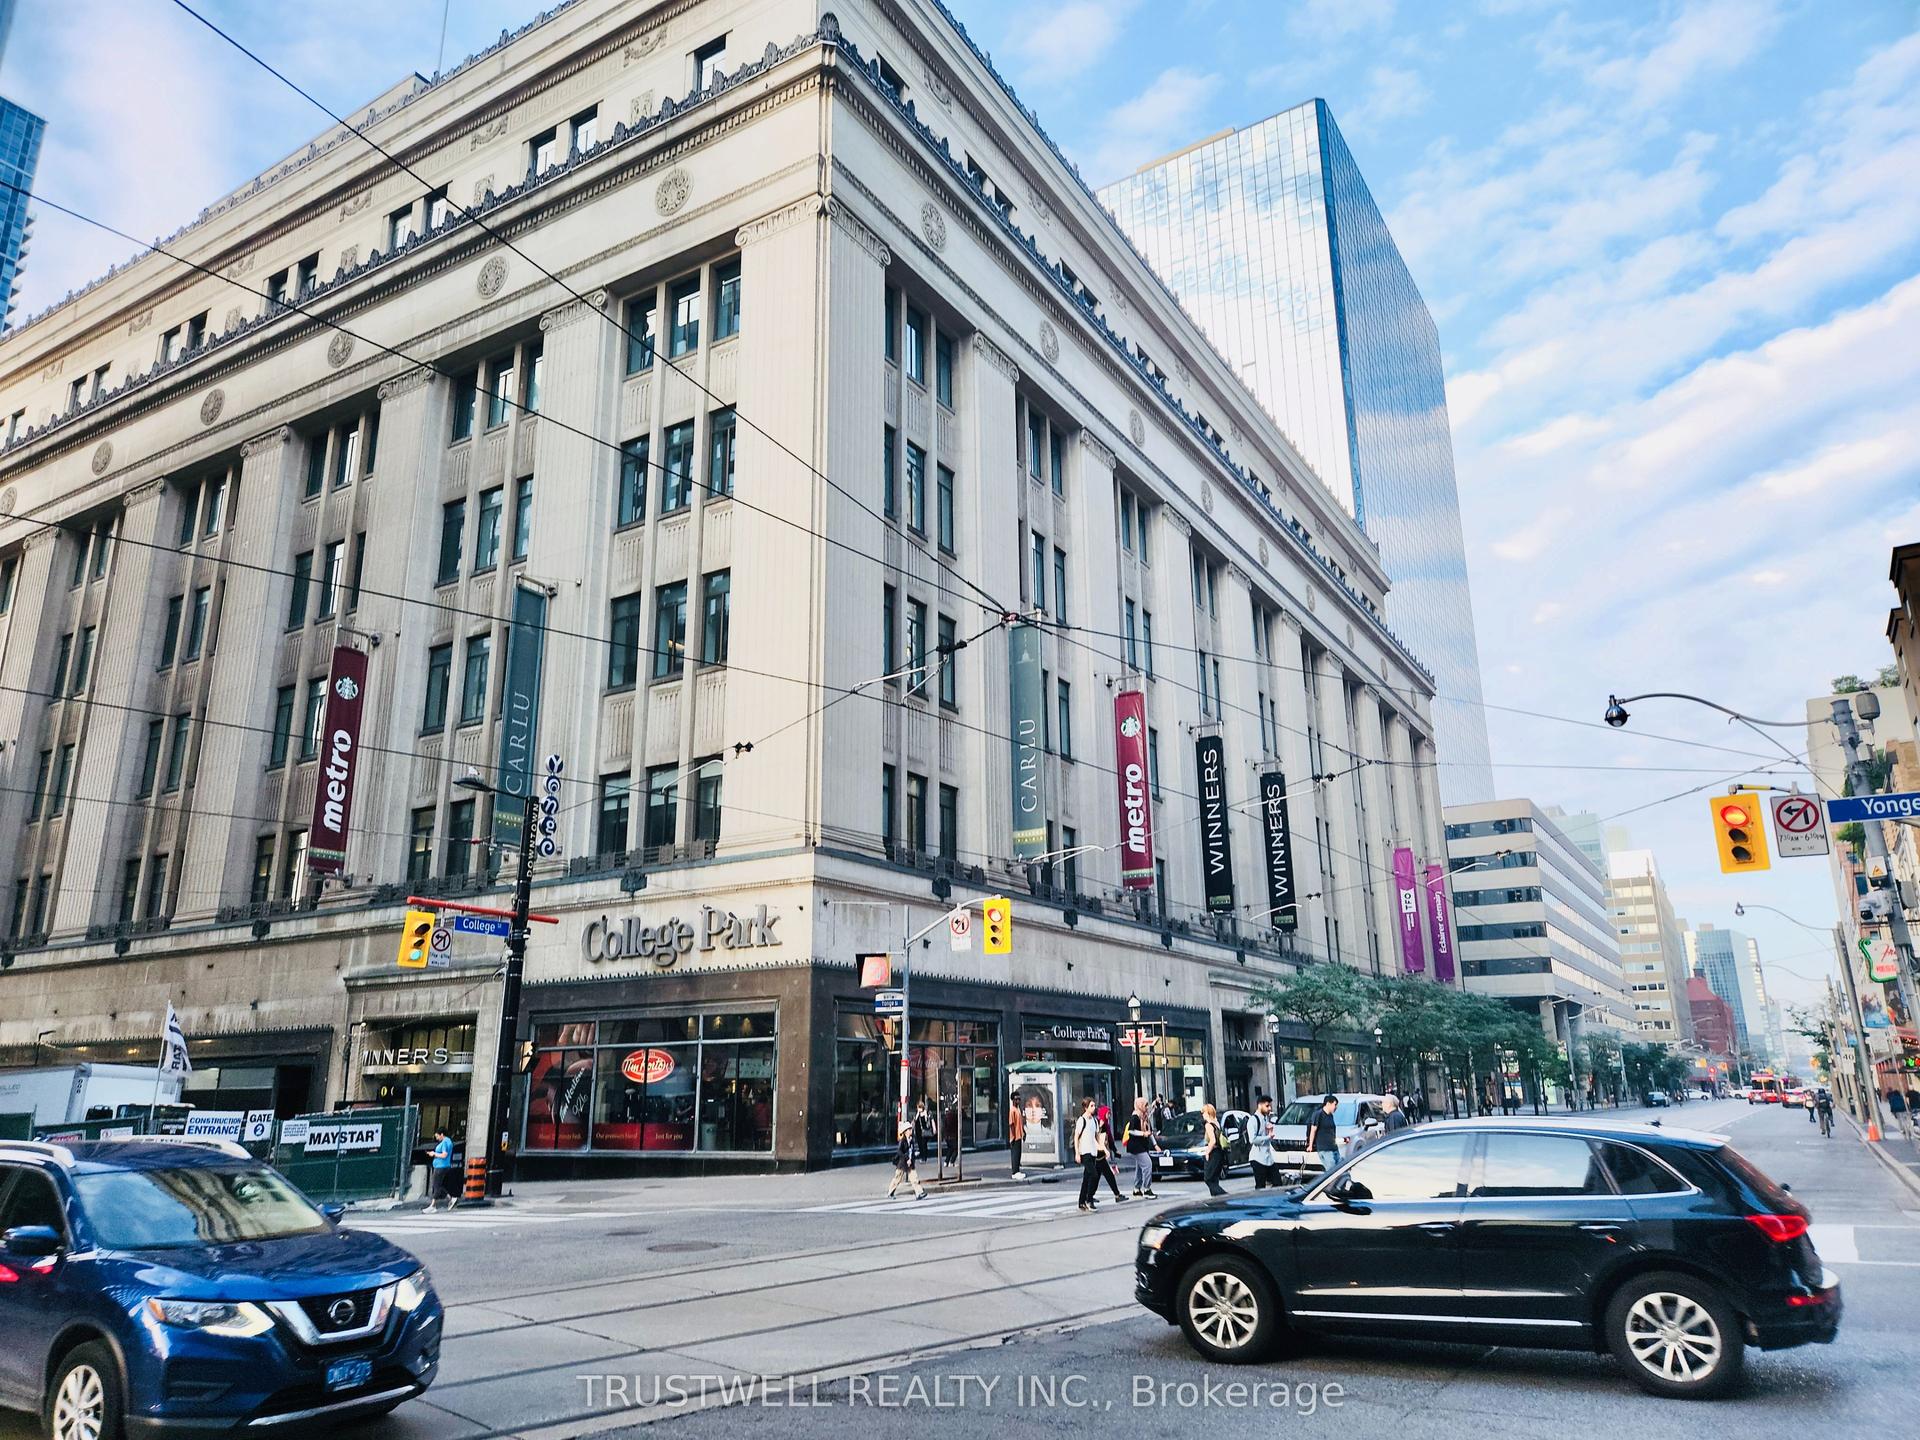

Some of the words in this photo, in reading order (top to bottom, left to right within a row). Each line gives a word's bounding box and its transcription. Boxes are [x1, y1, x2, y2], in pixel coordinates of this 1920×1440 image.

[505, 690, 531, 796] CARLU
[323, 729, 352, 834] metro
[1018, 718, 1038, 813] CARLU
[1124, 763, 1146, 853] metro
[1203, 748, 1226, 875] WINNERS
[1861, 798, 1920, 816] Yonge
[526, 802, 540, 879] DOWNTOWN
[1266, 784, 1289, 897] WINNERS
[1404, 892, 1412, 911] TFO
[462, 918, 496, 934] College
[582, 915, 695, 967] College
[699, 904, 784, 952] Park
[1052, 1024, 1086, 1041] College
[187, 1125, 240, 1135] ENTRANCE
[190, 1117, 241, 1125] CONSTRUCTION
[249, 1113, 272, 1123] GATE
[308, 1130, 375, 1146] MAYSTAR
